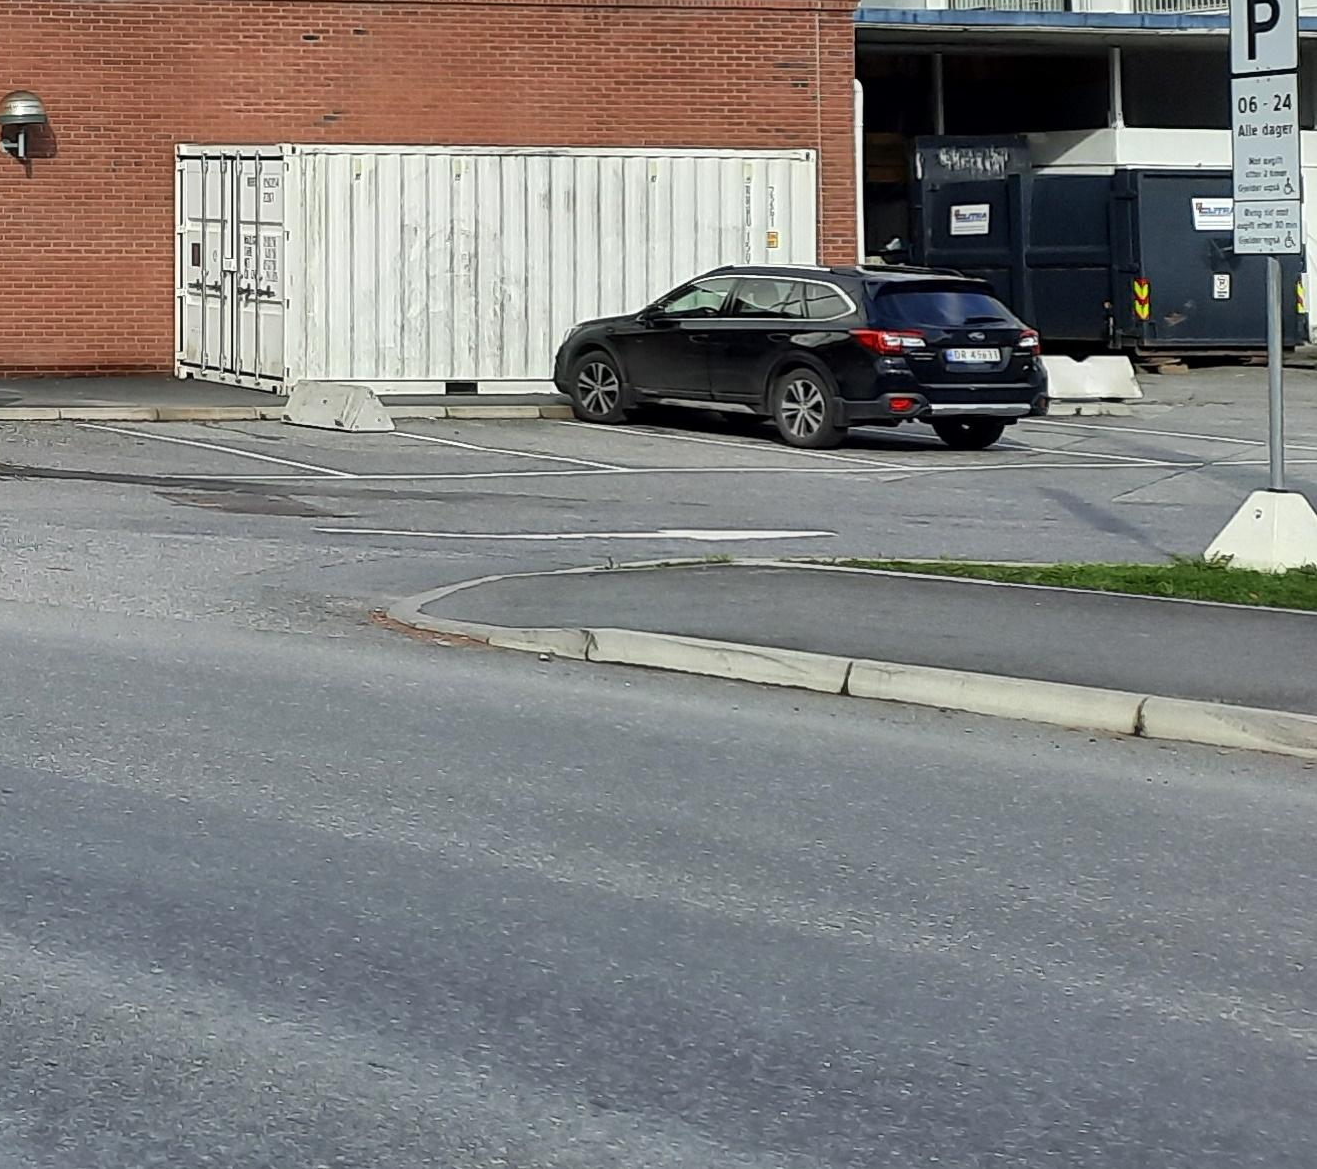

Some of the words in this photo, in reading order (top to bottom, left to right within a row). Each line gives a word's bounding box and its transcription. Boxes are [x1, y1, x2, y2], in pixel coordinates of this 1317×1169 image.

[1238, 96, 1258, 114] 06
[1273, 93, 1292, 111] 24
[1238, 124, 1258, 136] Alle
[1262, 123, 1293, 138] dager
